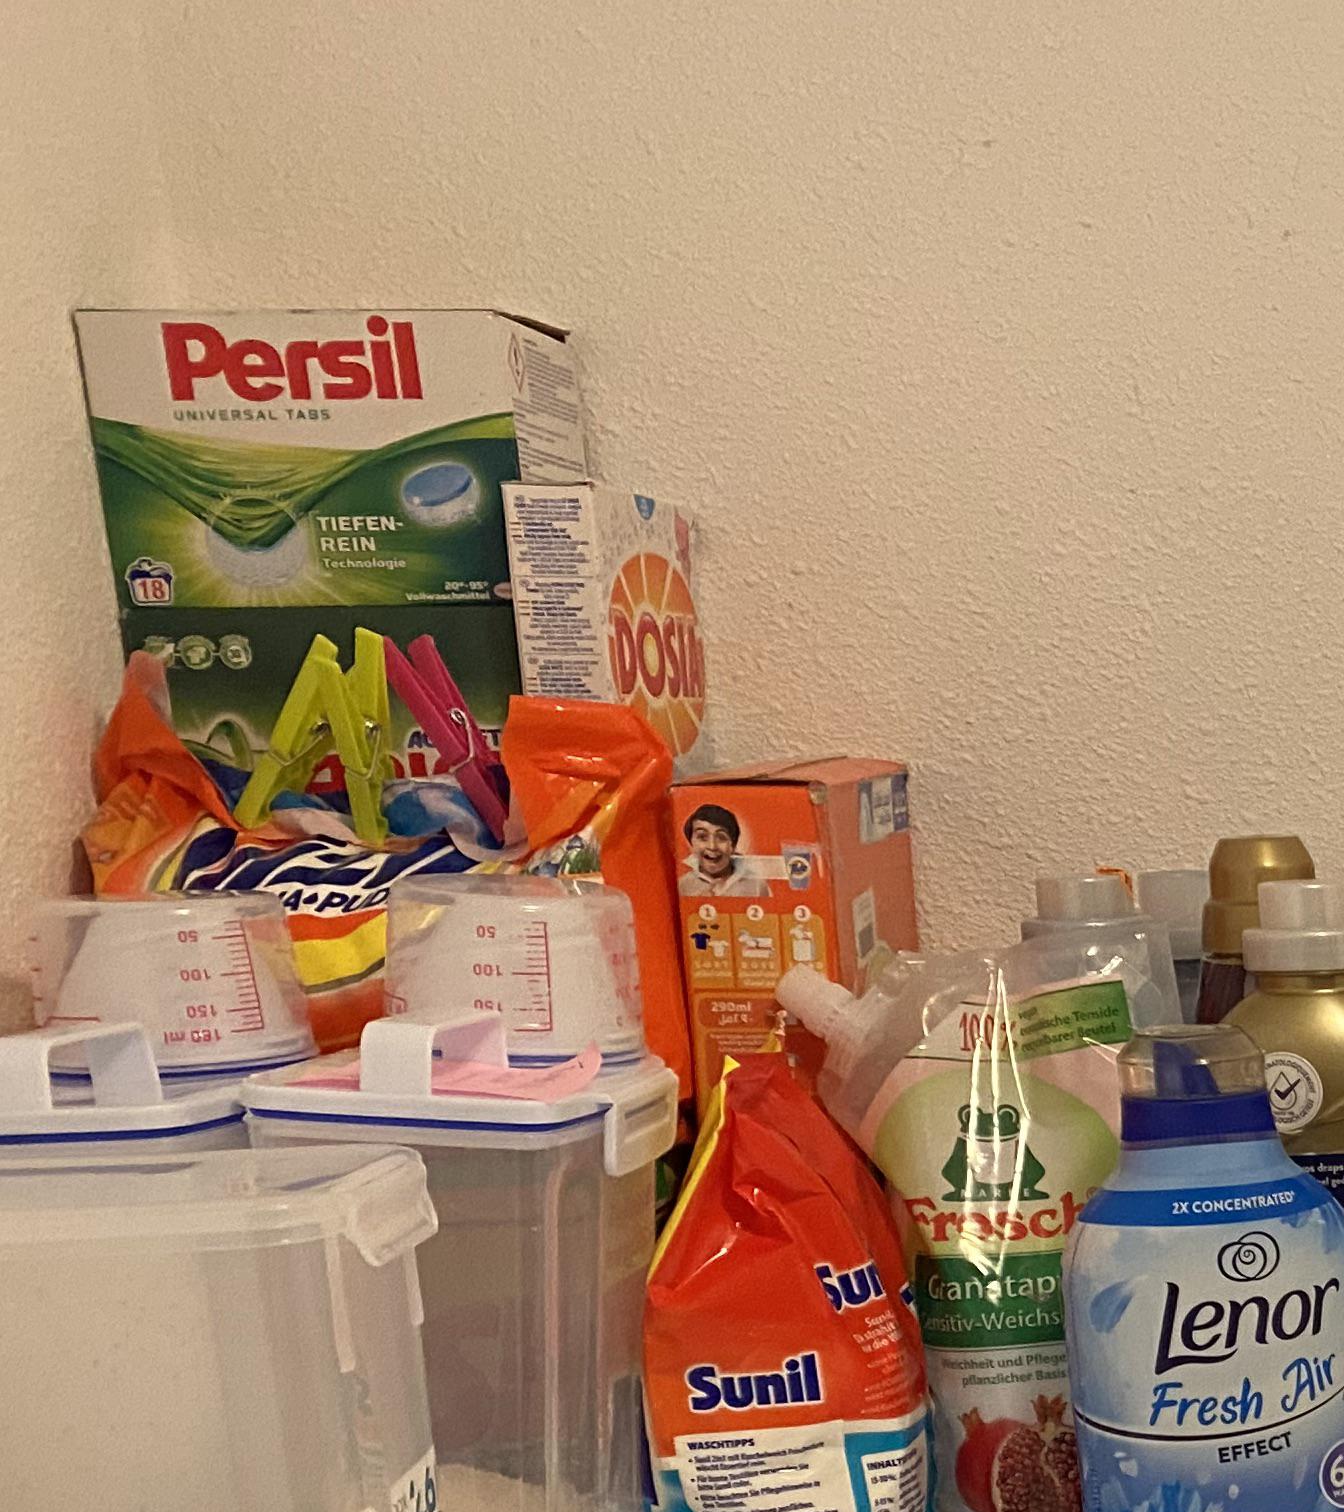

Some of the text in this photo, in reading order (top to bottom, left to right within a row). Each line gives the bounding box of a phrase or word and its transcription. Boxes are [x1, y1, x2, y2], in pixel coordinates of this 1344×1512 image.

[162, 315, 423, 402] Persil
[174, 408, 331, 422] UNIVERSAL TABS
[316, 515, 404, 533] TIEFEN-
[321, 536, 376, 552] REIN
[322, 556, 406, 571] Technologie
[139, 579, 166, 600] 18
[180, 969, 211, 981] 100
[472, 963, 502, 976] 100
[186, 1006, 217, 1018] 150
[1172, 1201, 1189, 1215] 2X
[1155, 1277, 1340, 1375] Lenor
[686, 1353, 822, 1412] Sunil
[1149, 1354, 1335, 1427] Fresh Air
[687, 1438, 755, 1450] WASCHTIPPS
[1218, 1432, 1292, 1463] EFFECT
